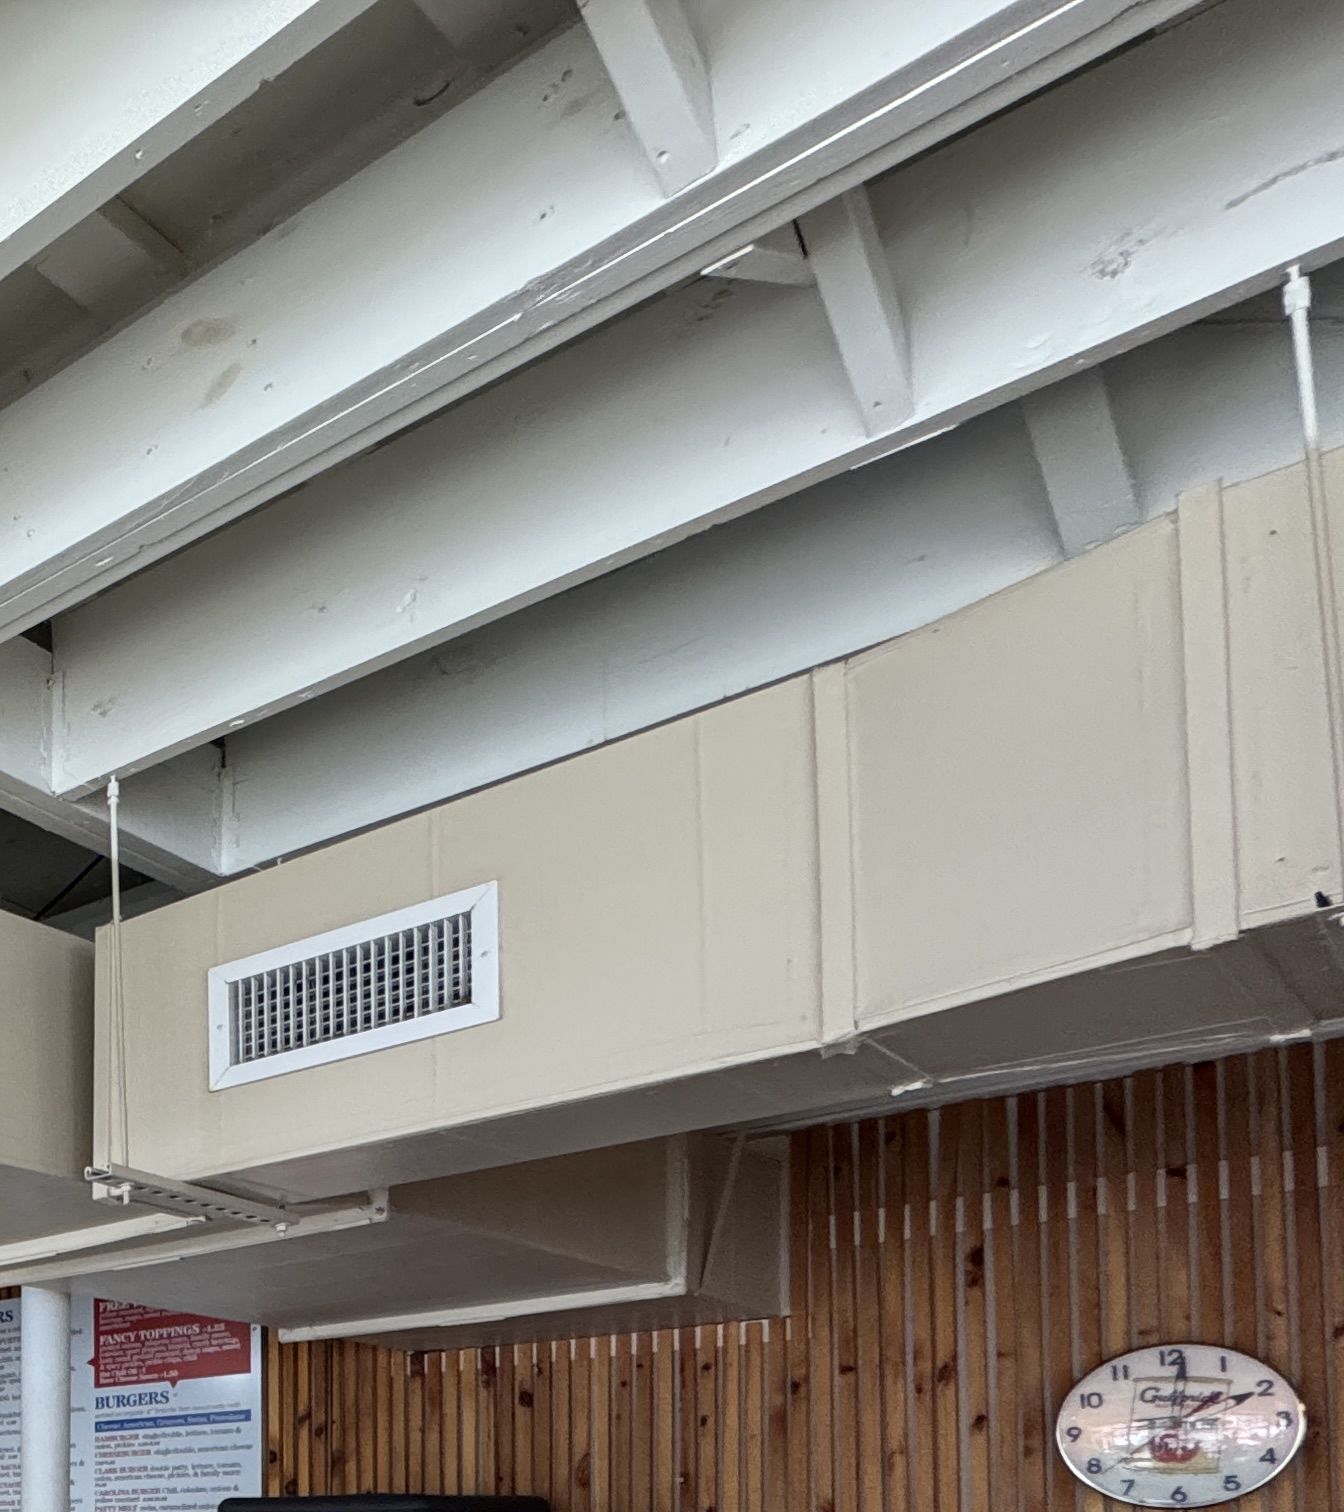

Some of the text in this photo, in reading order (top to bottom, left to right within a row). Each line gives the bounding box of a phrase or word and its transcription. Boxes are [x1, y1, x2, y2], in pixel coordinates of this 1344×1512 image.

[100, 1323, 200, 1346] FANCY TOPPINGS
[1220, 1356, 1227, 1372] 1
[1112, 1365, 1129, 1380] 11
[1256, 1380, 1274, 1397] 2
[96, 1391, 169, 1409] BURGERS
[1080, 1392, 1103, 1408] 10
[1066, 1427, 1082, 1442] 9
[1259, 1448, 1278, 1464] 4
[1087, 1458, 1101, 1474] 8
[1121, 1480, 1136, 1495] 7
[1223, 1475, 1241, 1491] 5
[1171, 1487, 1188, 1503] 6
